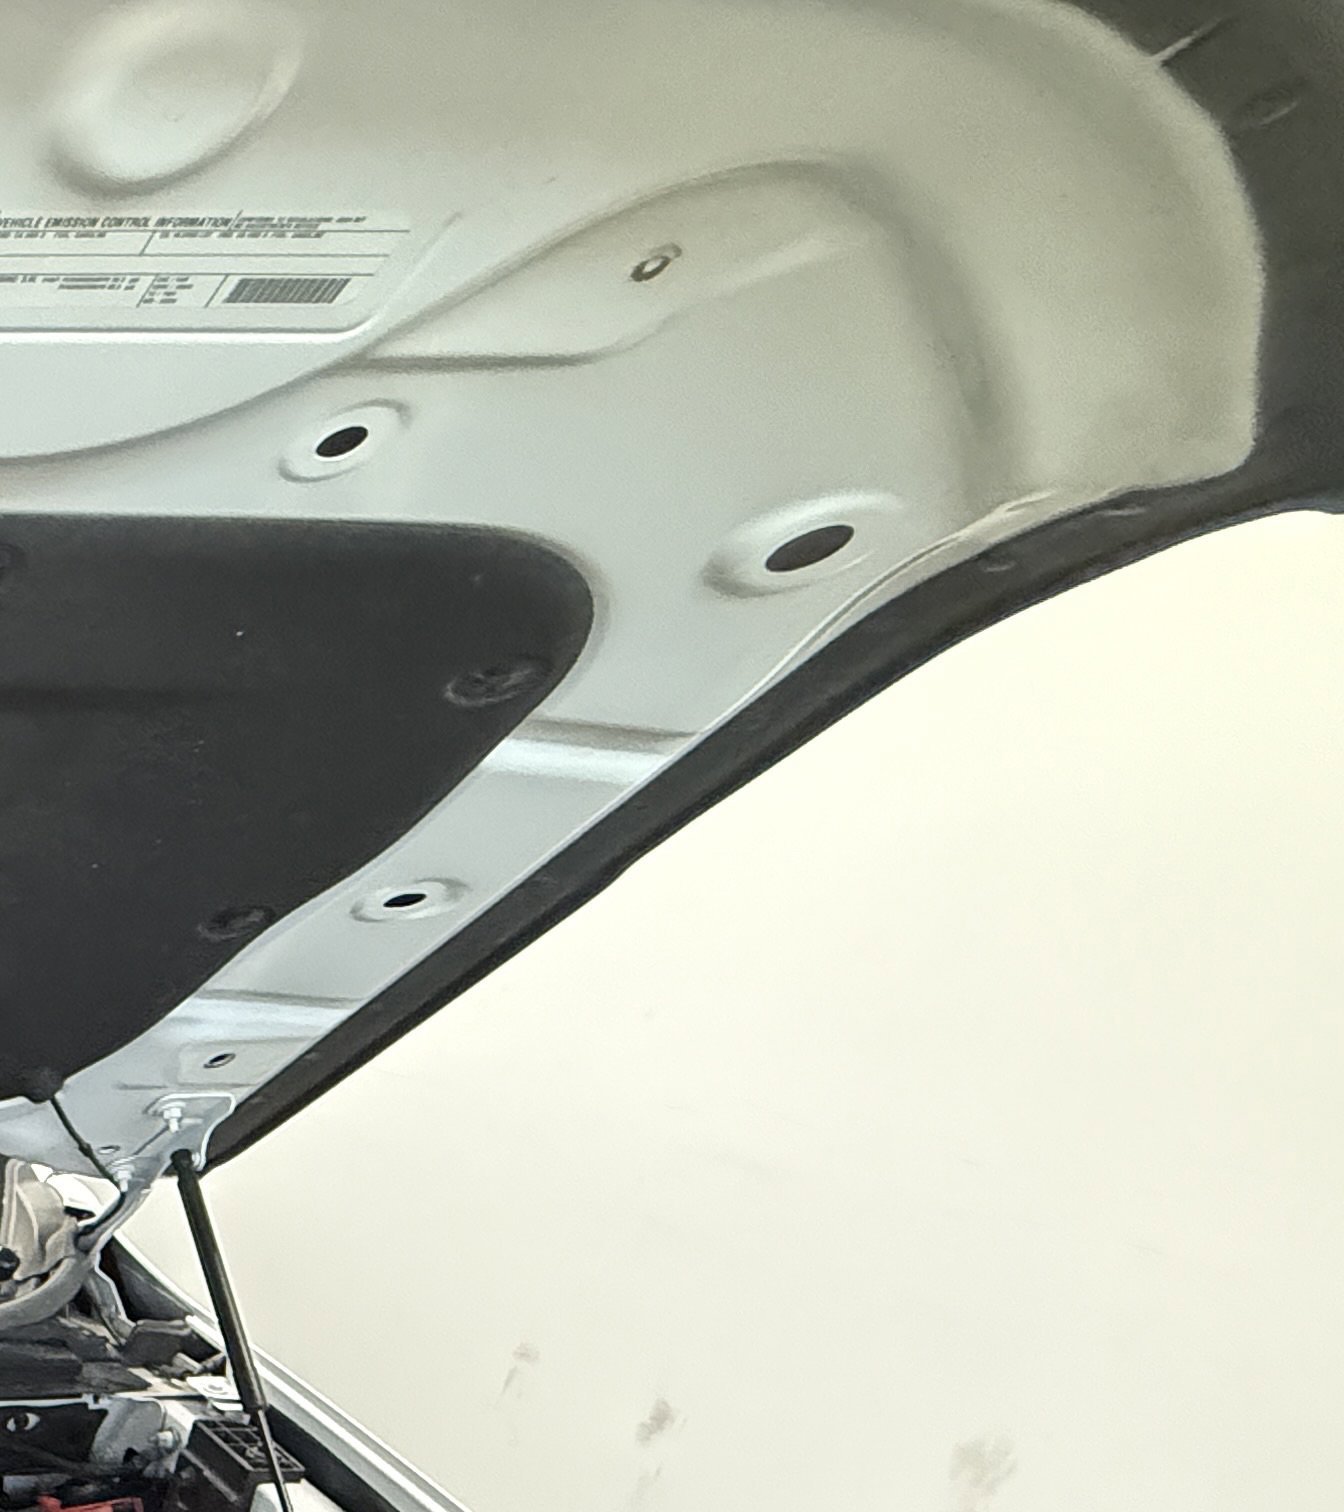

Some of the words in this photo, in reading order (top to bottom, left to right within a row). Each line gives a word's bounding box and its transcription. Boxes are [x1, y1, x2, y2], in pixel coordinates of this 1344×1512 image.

[44, 216, 99, 229] EMISSION
[100, 216, 152, 228] CONTROL
[154, 216, 232, 228] INFORMATION
